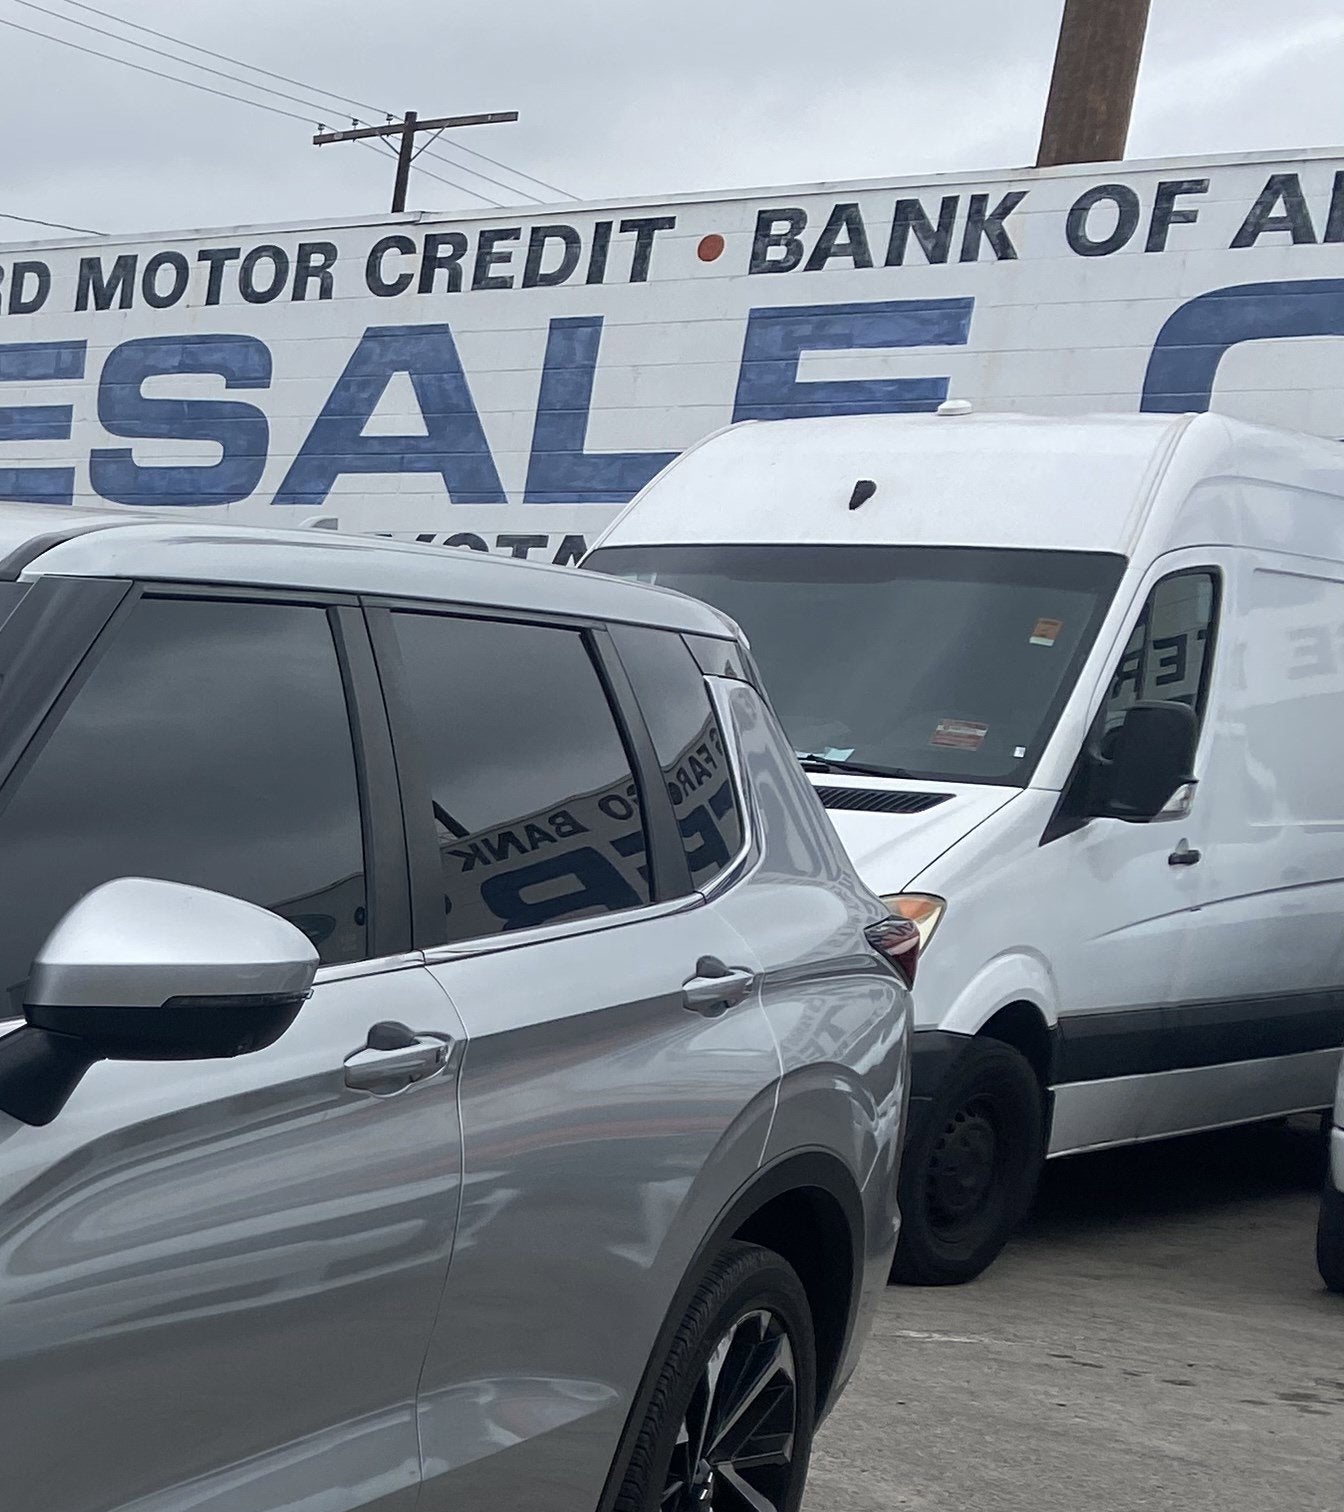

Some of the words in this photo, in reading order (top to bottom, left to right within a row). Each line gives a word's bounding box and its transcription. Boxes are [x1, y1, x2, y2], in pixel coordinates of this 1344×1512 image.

[75, 242, 338, 312] MOTOR
[366, 215, 676, 298] CREDIT
[749, 190, 1029, 275] BANK
[1066, 178, 1209, 257] OF
[1229, 171, 1344, 250] A
